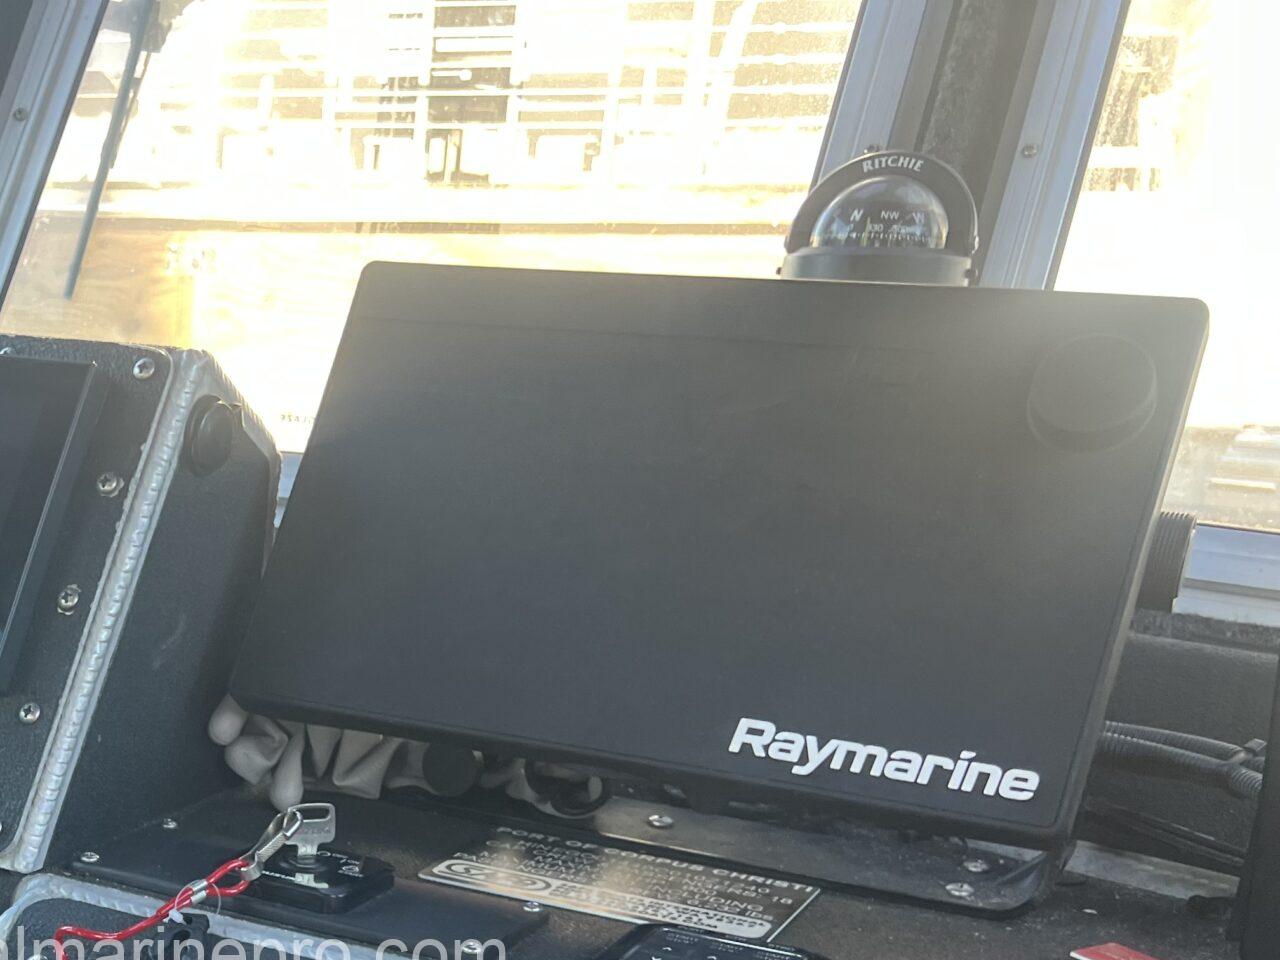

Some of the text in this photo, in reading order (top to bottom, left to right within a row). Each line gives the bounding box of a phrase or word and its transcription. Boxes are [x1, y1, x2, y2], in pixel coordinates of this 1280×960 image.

[862, 155, 924, 173] RITCHIE
[850, 209, 864, 221] N
[881, 210, 900, 220] NW
[728, 717, 1040, 801] Raymarine
[493, 825, 562, 843] PORT
[562, 838, 599, 850] OF
[600, 845, 706, 872] CORPUS
[708, 866, 816, 893] CHRISTI
